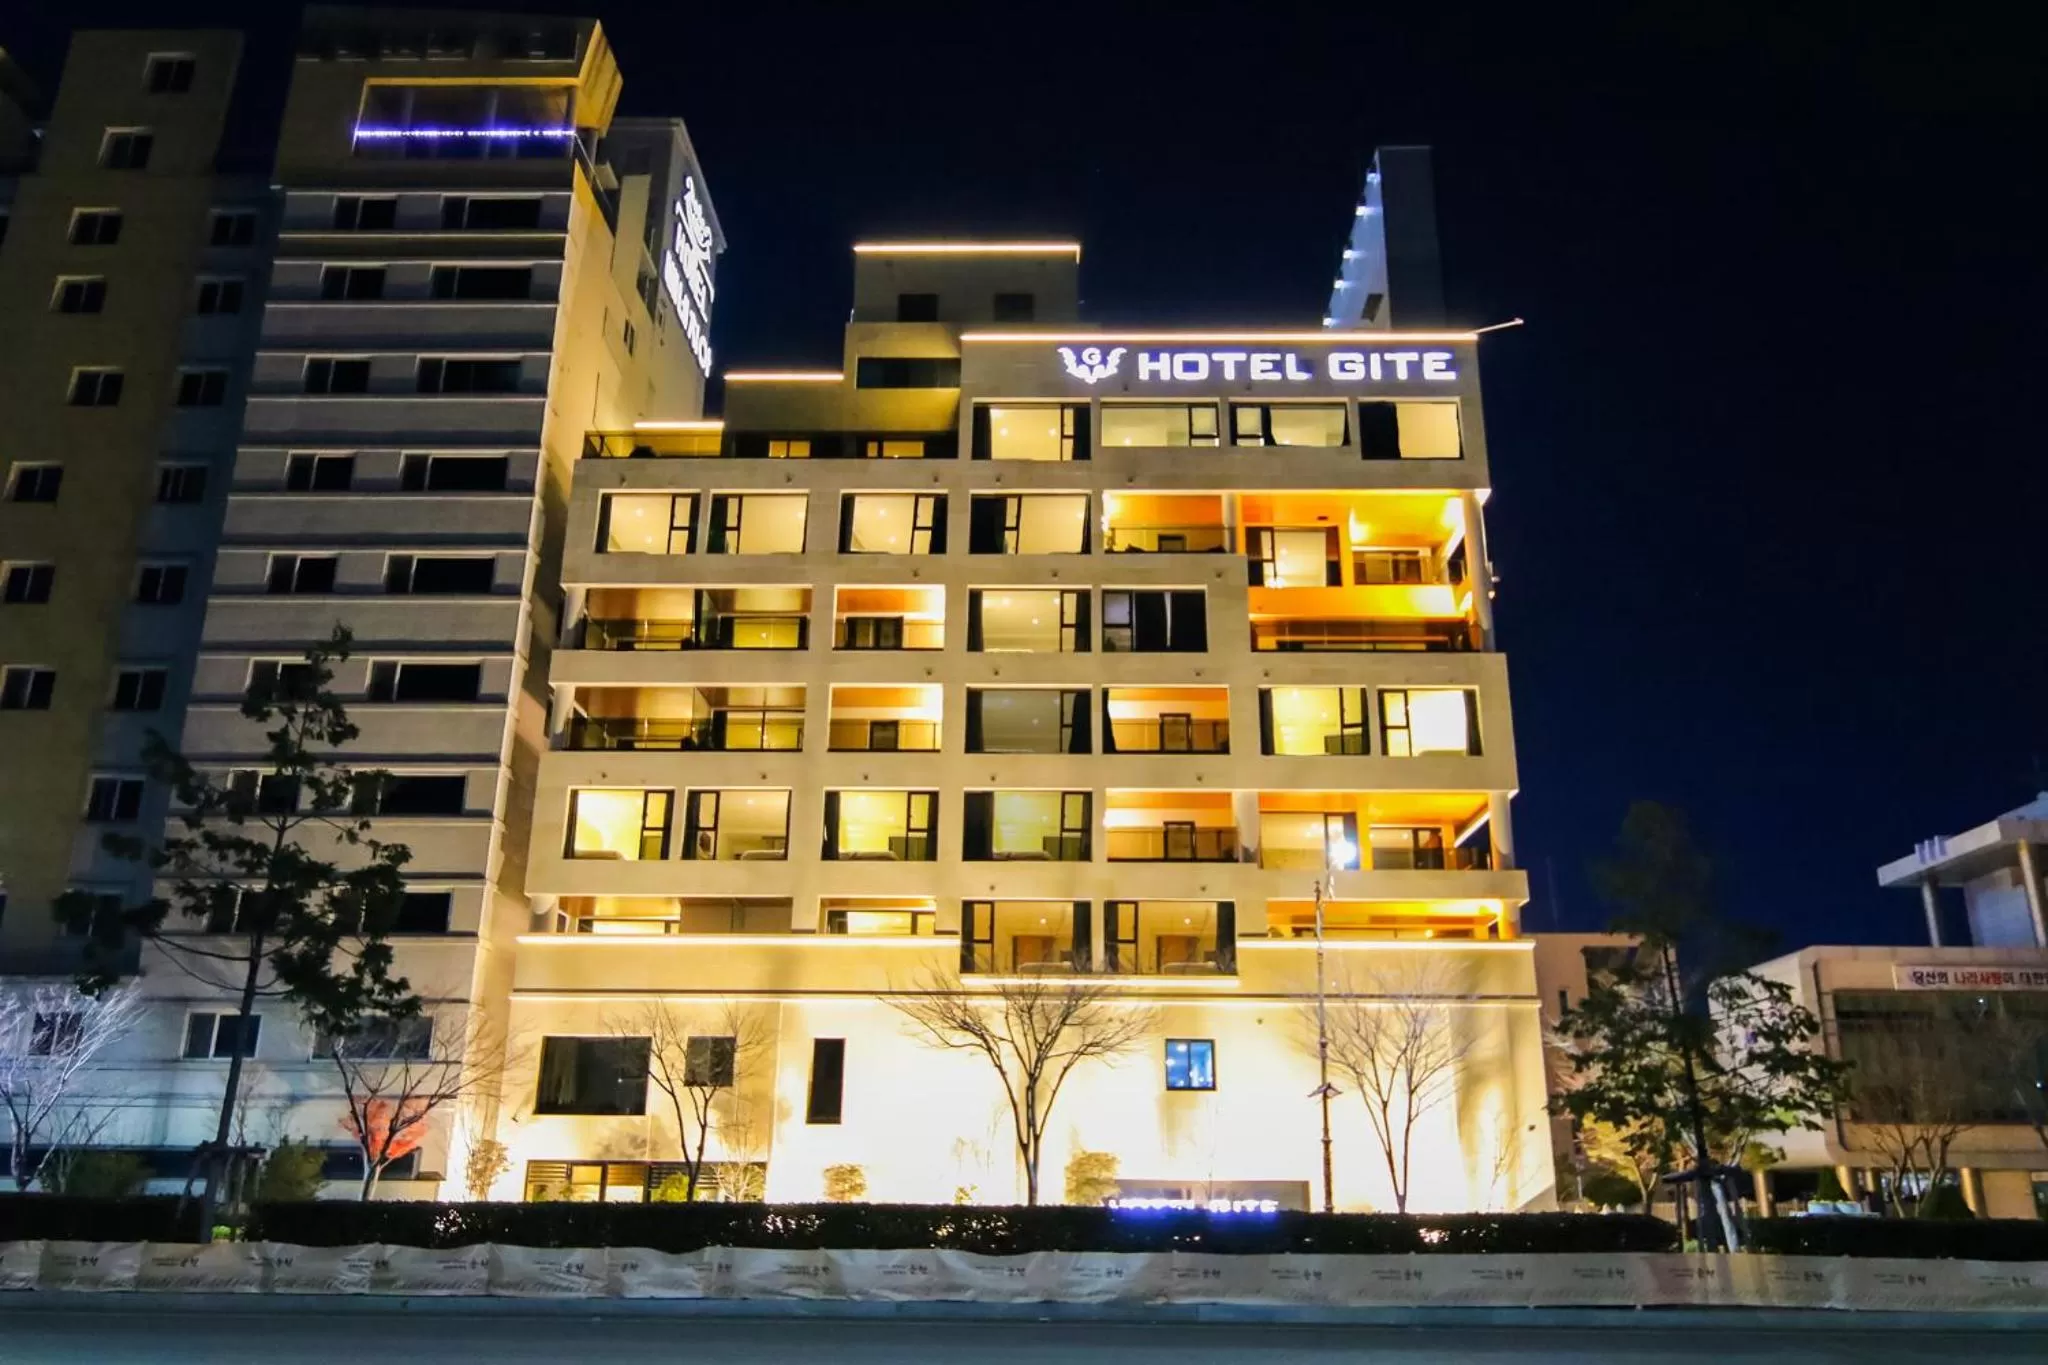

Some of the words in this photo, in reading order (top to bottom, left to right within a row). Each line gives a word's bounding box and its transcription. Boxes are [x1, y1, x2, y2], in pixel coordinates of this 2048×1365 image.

[1138, 352, 1311, 381] HOTEL
[1328, 352, 1457, 381] GITE
[2019, 971, 2048, 985] 대한
